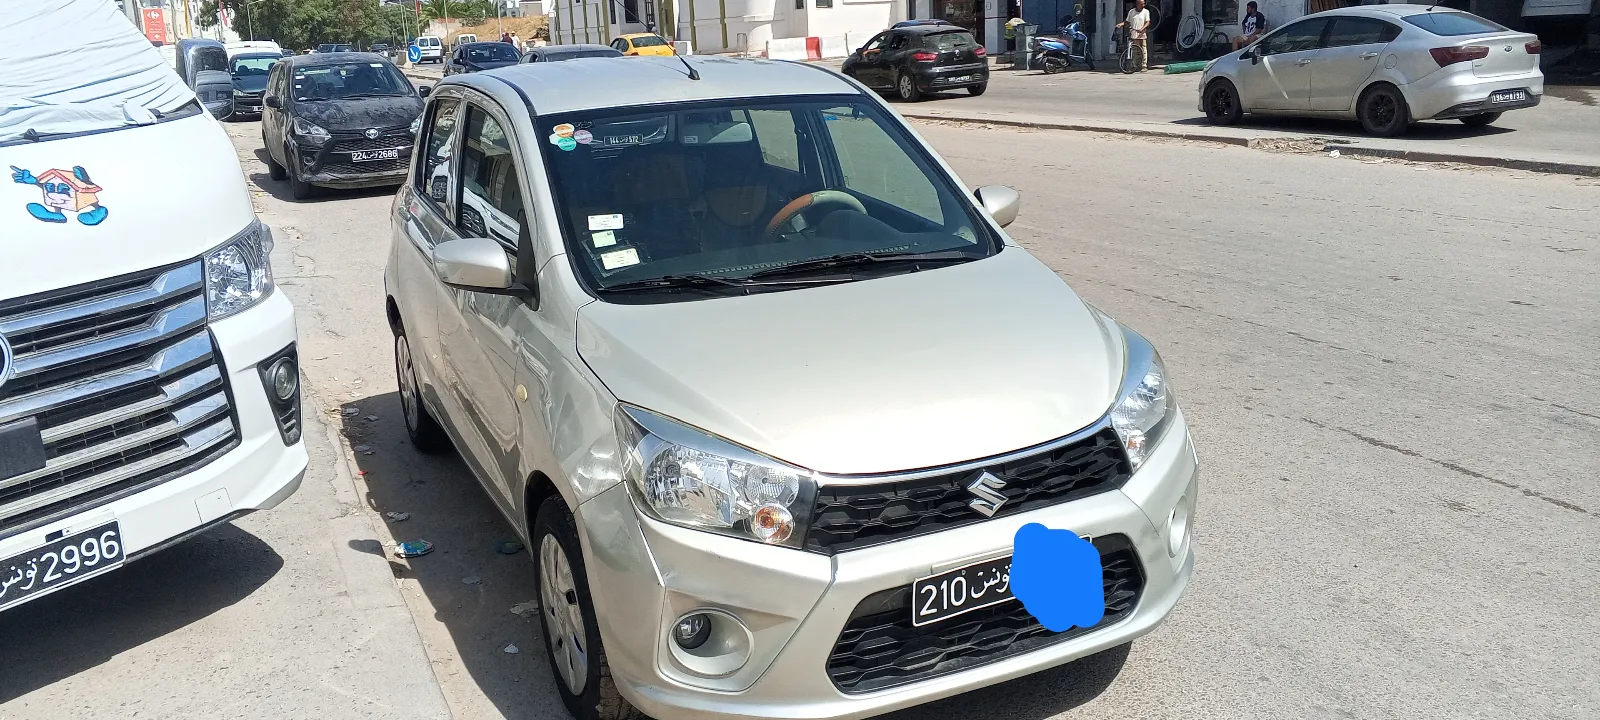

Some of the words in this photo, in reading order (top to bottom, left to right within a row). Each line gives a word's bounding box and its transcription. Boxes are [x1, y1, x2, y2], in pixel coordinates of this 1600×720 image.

[353, 152, 367, 160] 224
[378, 149, 398, 158] 2686
[40, 531, 119, 583] 2996
[919, 576, 967, 616] 210
